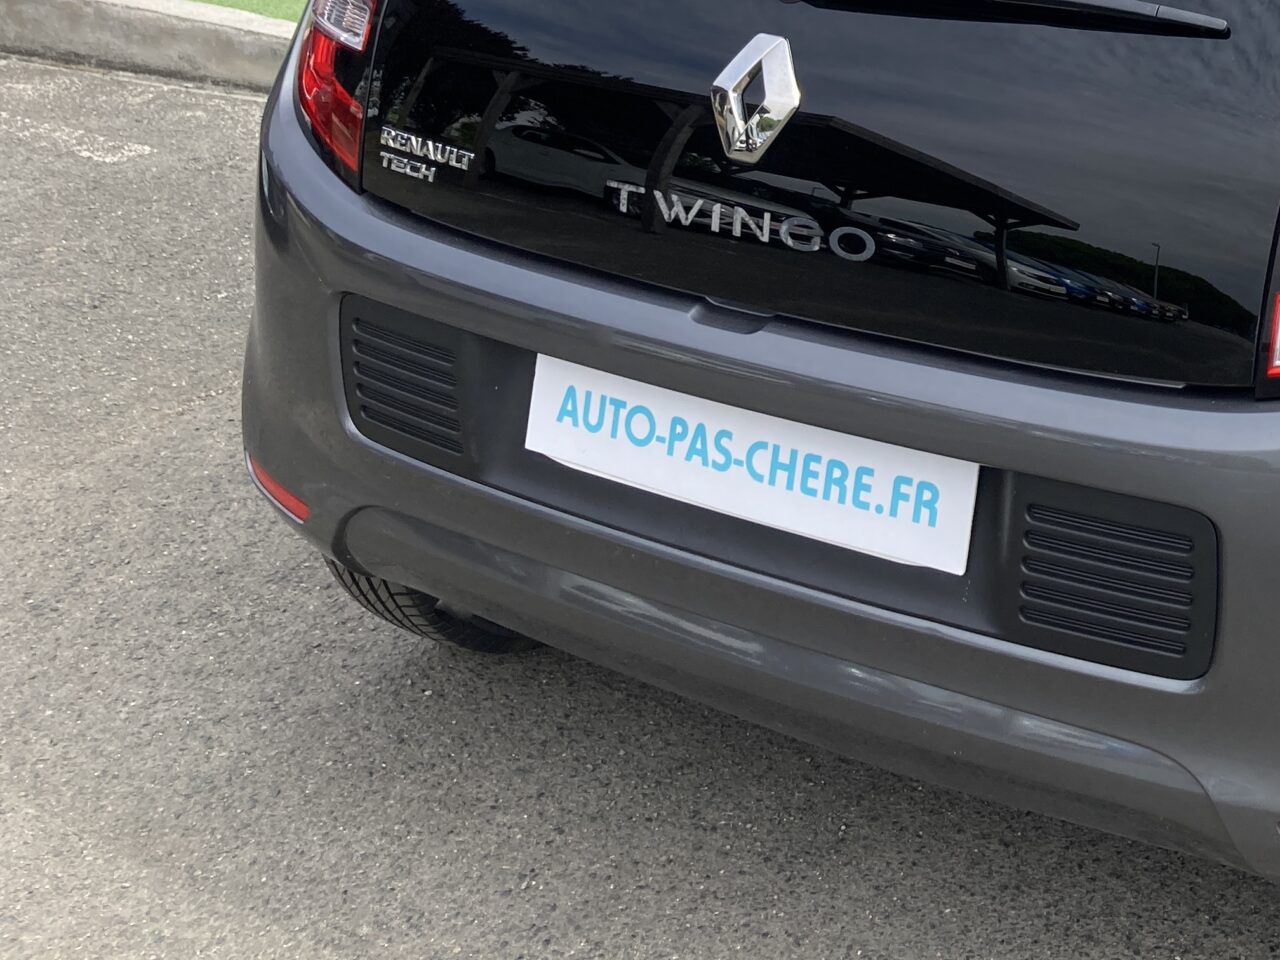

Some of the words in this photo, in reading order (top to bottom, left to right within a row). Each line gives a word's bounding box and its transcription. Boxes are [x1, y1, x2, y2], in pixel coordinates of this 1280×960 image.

[380, 125, 475, 171] RENAULT
[380, 151, 436, 183] TECH
[606, 179, 876, 262] TWINGO
[556, 384, 941, 528] AUTO-PAS-CHERE.FR
